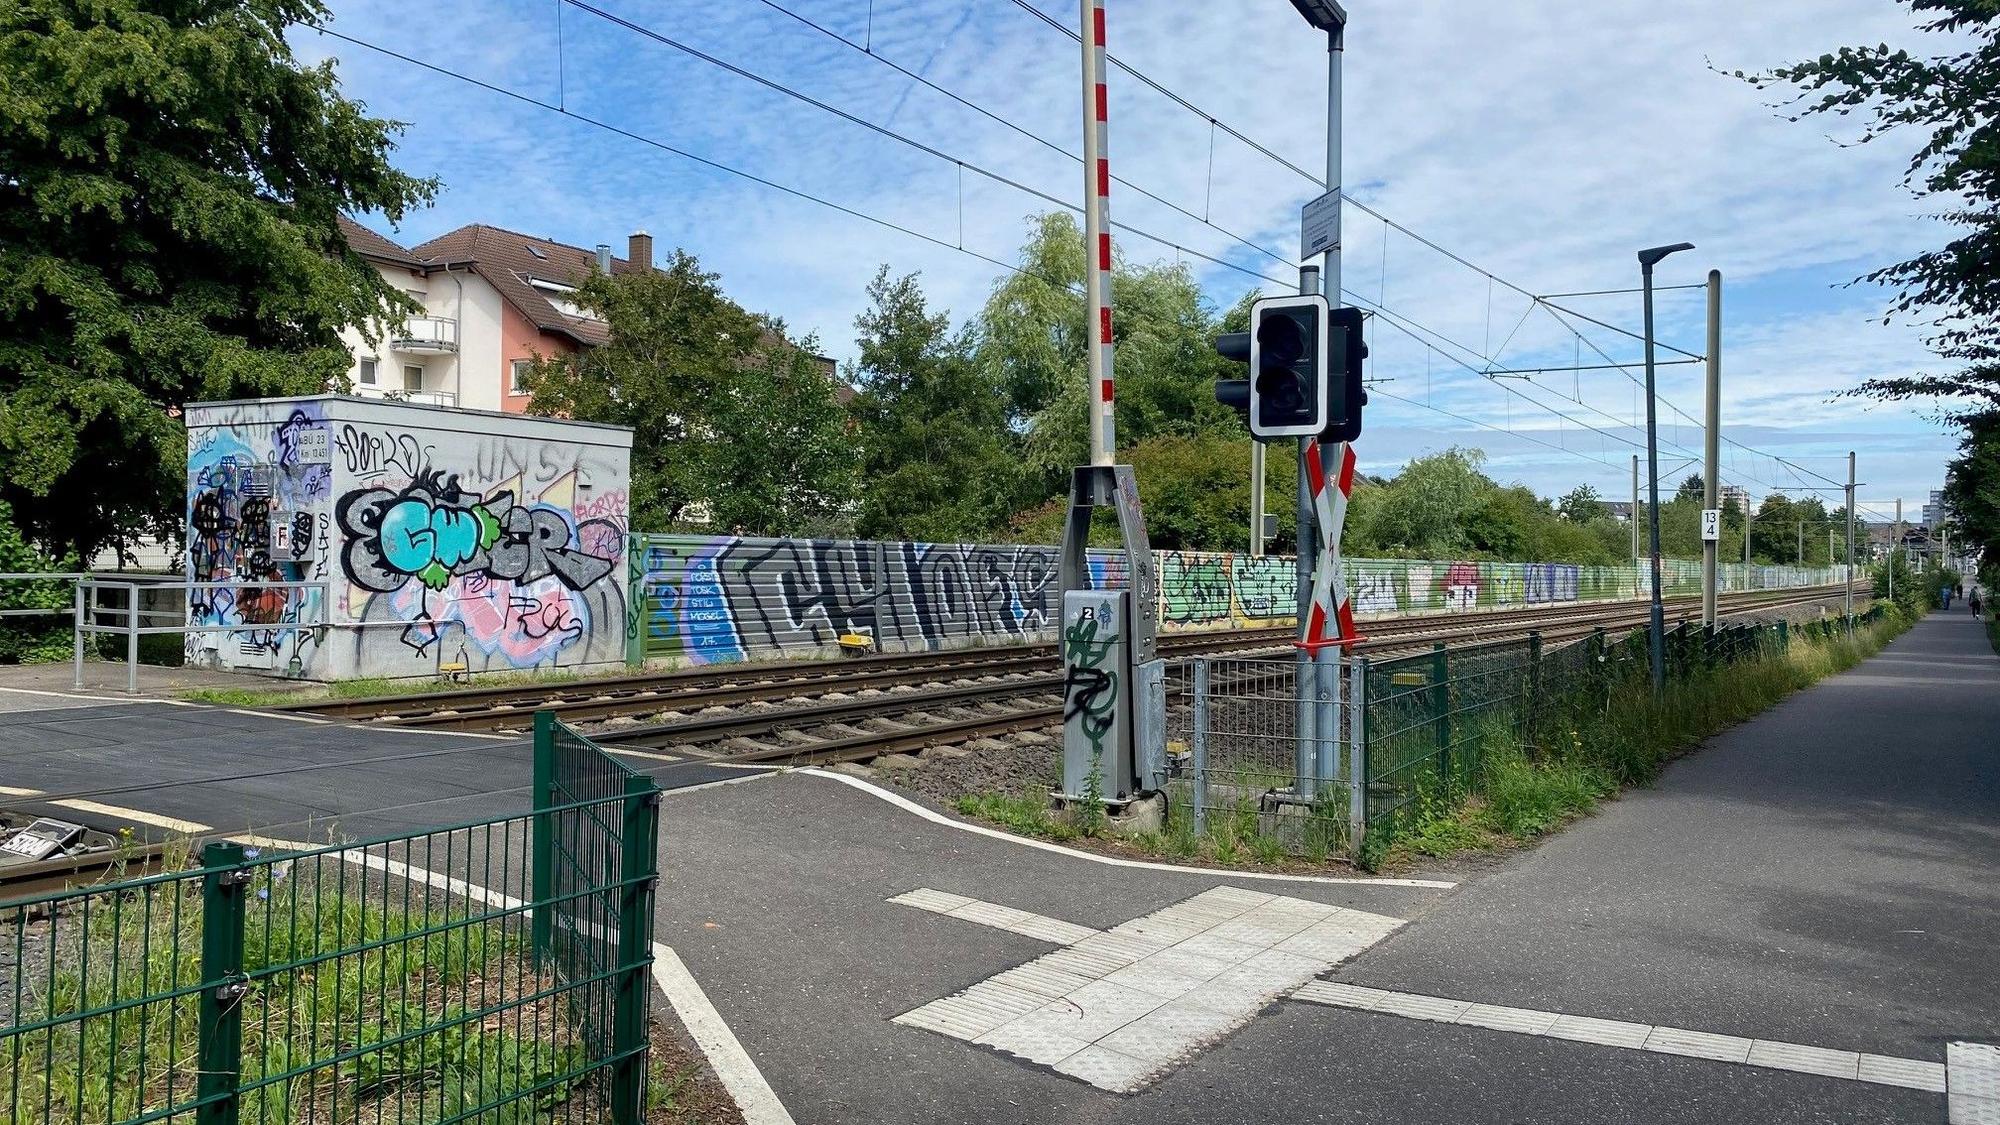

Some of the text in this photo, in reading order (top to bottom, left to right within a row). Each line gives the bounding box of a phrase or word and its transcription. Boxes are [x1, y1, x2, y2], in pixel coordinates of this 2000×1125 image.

[317, 435, 325, 445] 23
[1705, 512, 1716, 523] 13
[1707, 525, 1715, 535] 4
[278, 526, 288, 546] F
[1084, 608, 1092, 619] 2
